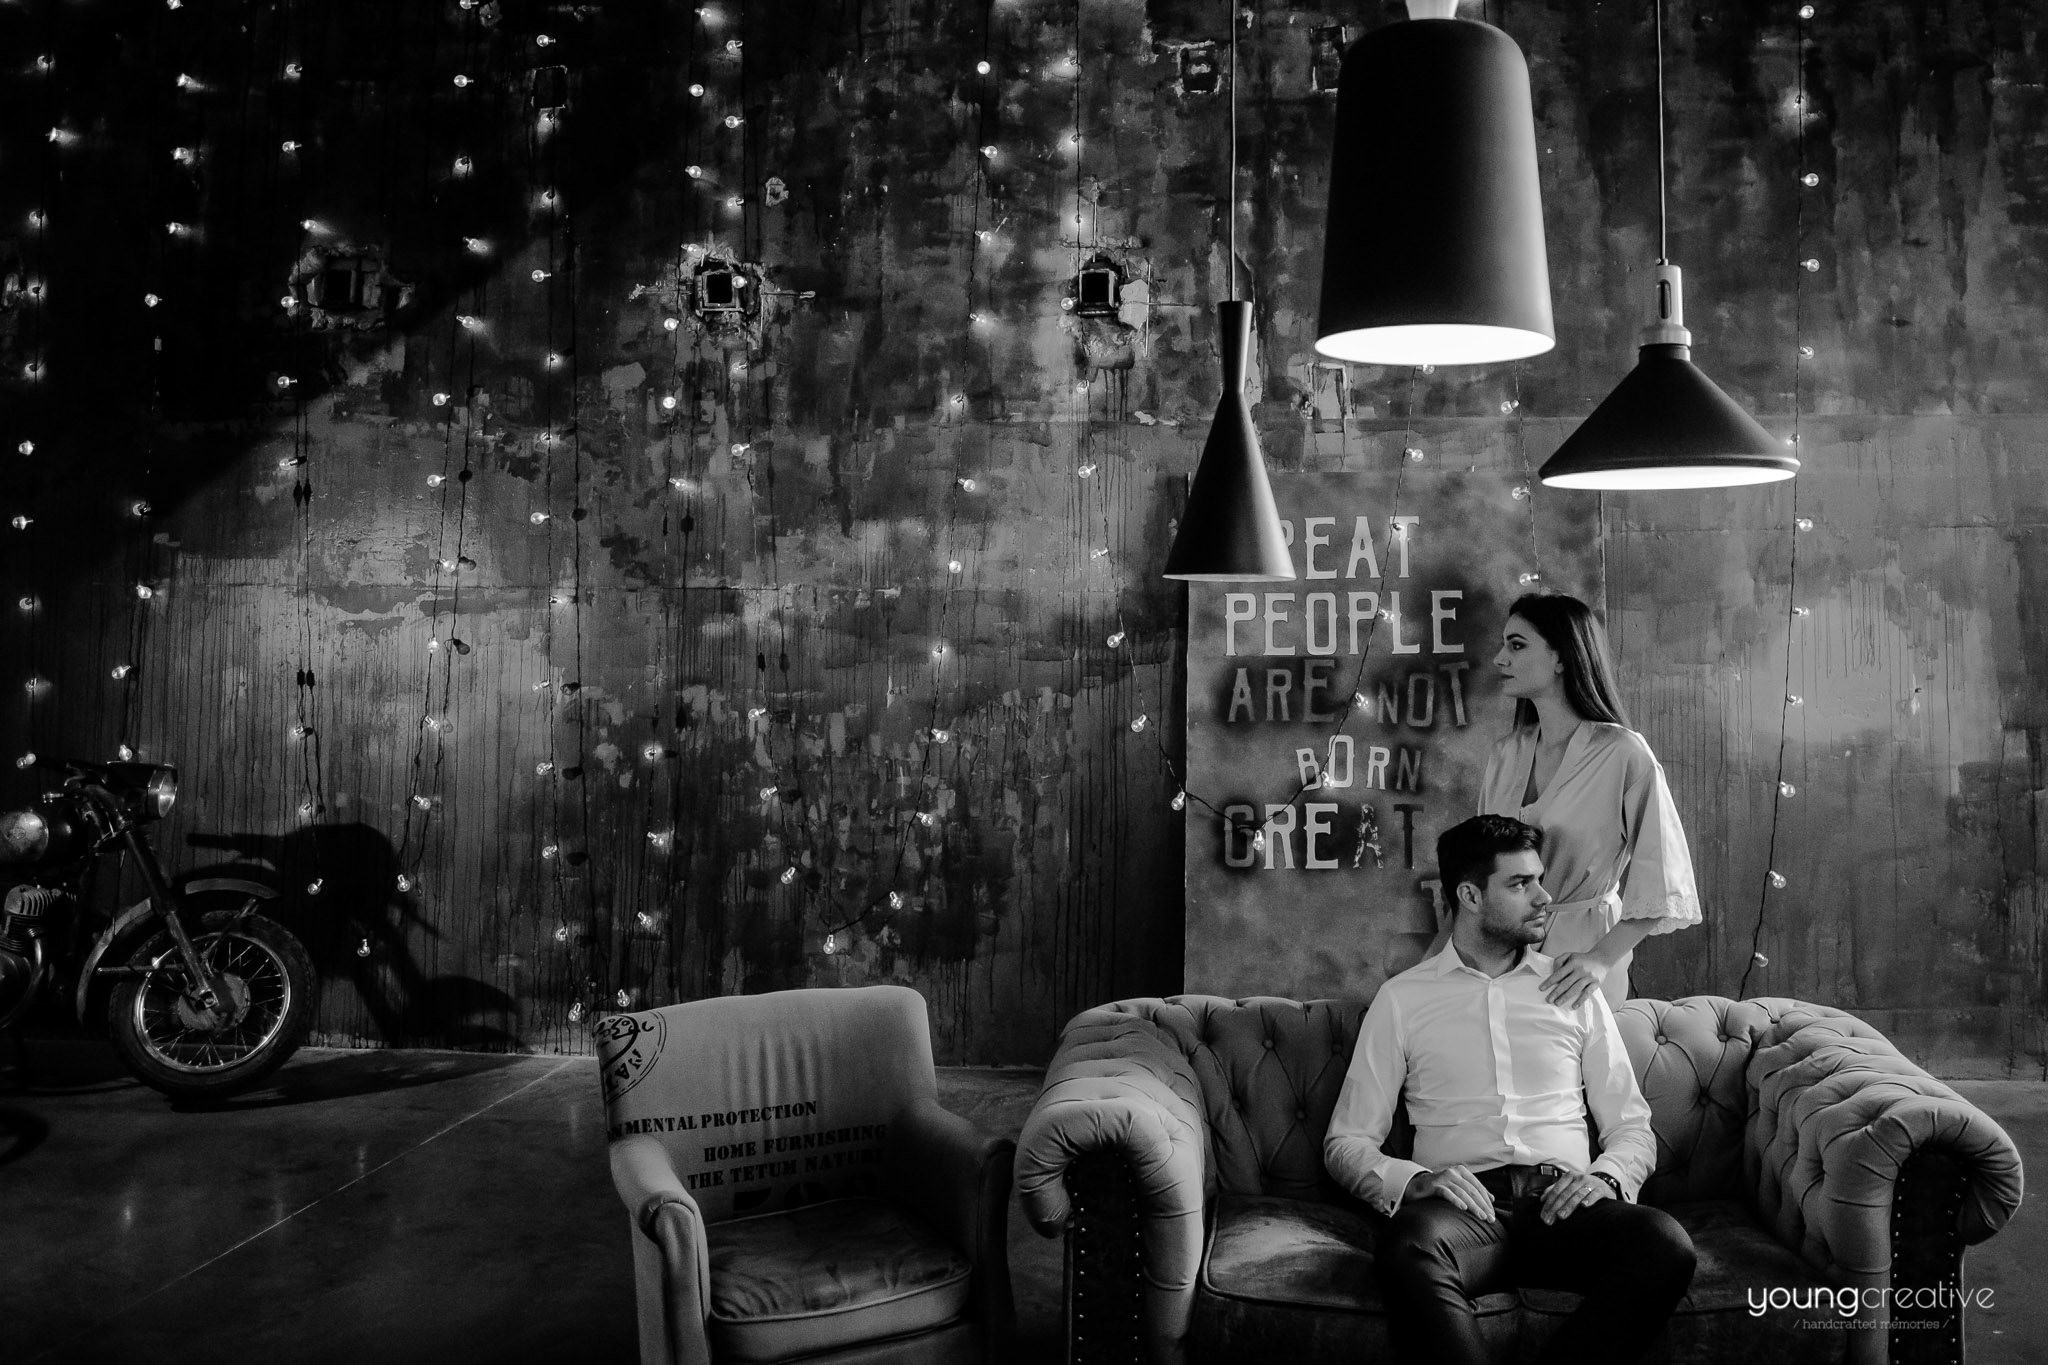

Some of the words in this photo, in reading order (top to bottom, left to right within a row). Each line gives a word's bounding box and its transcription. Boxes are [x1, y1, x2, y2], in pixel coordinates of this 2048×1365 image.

[1224, 589, 1465, 656] PEOPLE
[1227, 658, 1336, 724] ARE
[1376, 660, 1471, 728] NOT
[1296, 734, 1423, 792] BORN
[1223, 802, 1425, 871] GREAT
[701, 1100, 818, 1129] PROTECTION
[703, 1141, 757, 1163] HOME
[763, 1123, 887, 1155] FURNISHING
[687, 1170, 724, 1190] THE
[730, 1159, 798, 1184] TETUM
